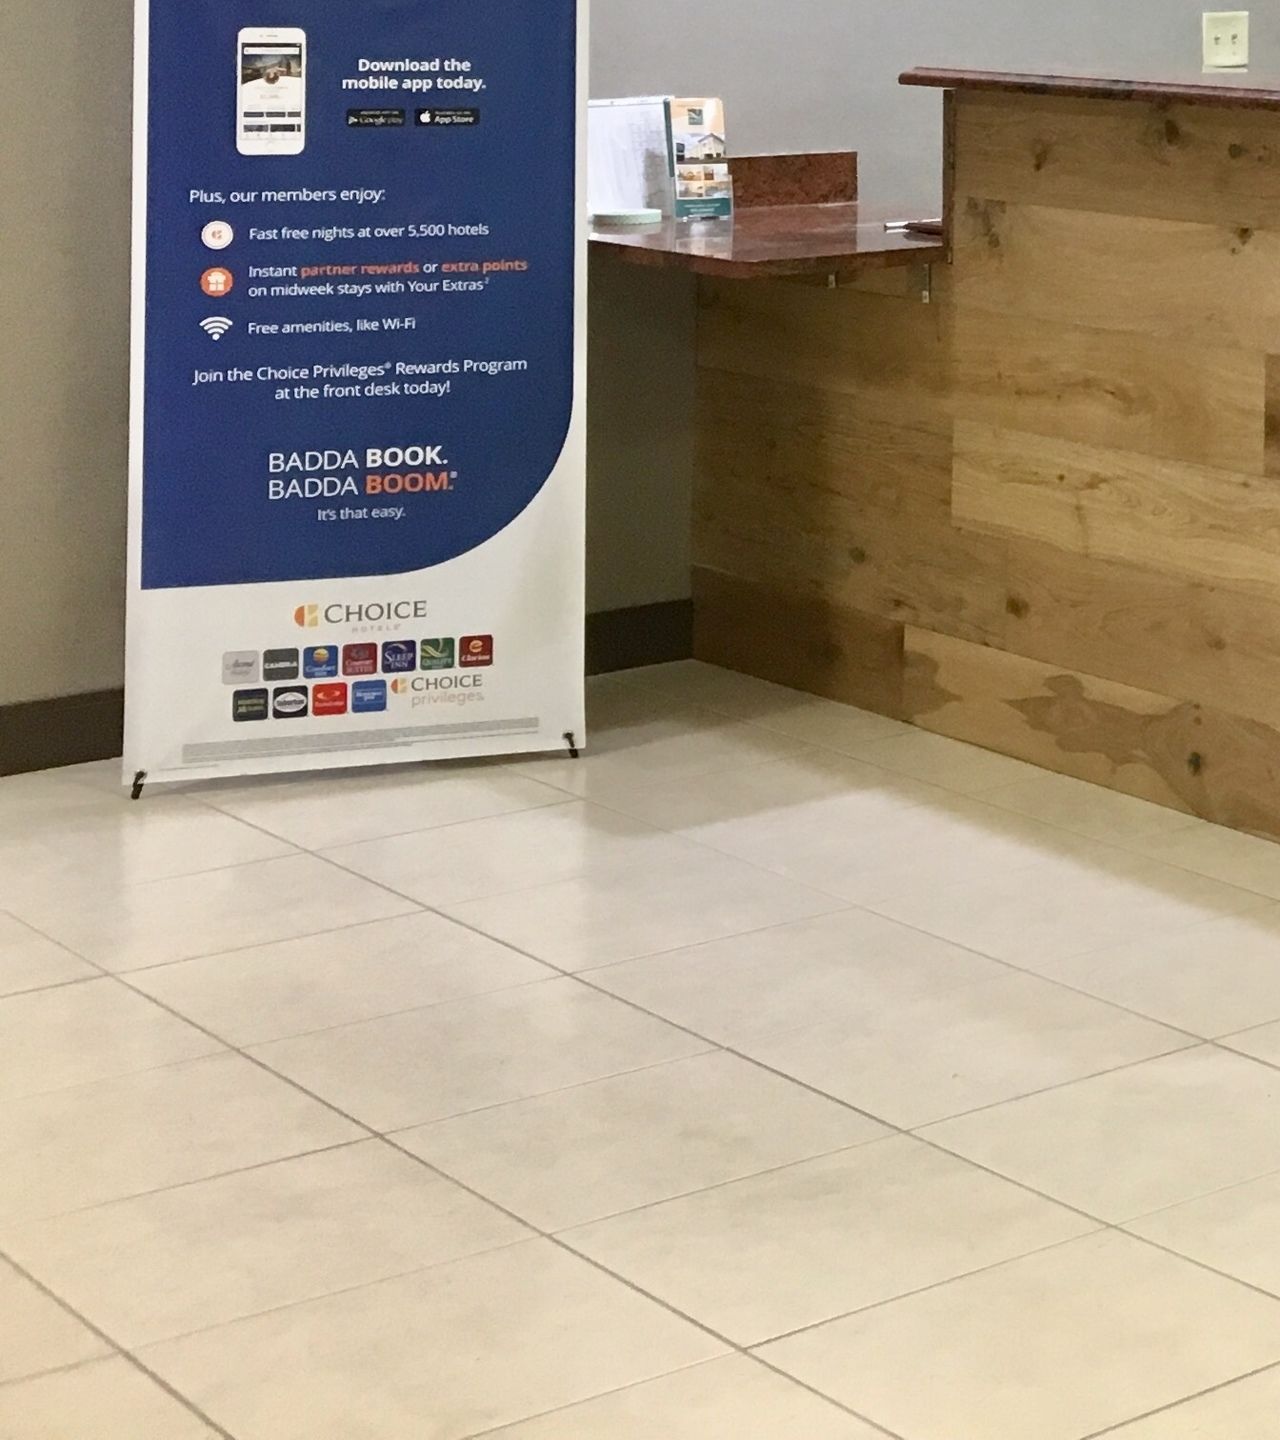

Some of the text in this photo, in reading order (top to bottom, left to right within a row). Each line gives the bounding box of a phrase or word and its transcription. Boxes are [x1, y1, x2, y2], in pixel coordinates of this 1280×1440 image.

[358, 59, 471, 72] Download the
[342, 76, 486, 92] mobile app today.
[189, 187, 386, 204] Plus, our members enjoy:
[249, 223, 489, 241] Fast free nights at over 5,500 hotels
[249, 259, 527, 279] Instant partner rewards or extra points
[248, 287, 267, 297] on
[271, 283, 334, 296] midweek
[337, 283, 373, 296] stays
[376, 281, 404, 293] with
[408, 280, 439, 293] Your
[248, 317, 416, 334] Free amenities, like Wi-Fi
[192, 369, 224, 385] Join
[227, 367, 253, 381] the
[257, 365, 309, 380] Choice
[396, 360, 459, 375] Rewards
[463, 358, 527, 375] Program
[275, 380, 451, 400] at the front desk today!
[269, 446, 447, 472] BADDA BOOK.
[268, 477, 358, 499] BADDA
[317, 505, 406, 521] It's that easy.
[324, 600, 427, 623] CHOICE
[411, 674, 482, 691] CHOICE
